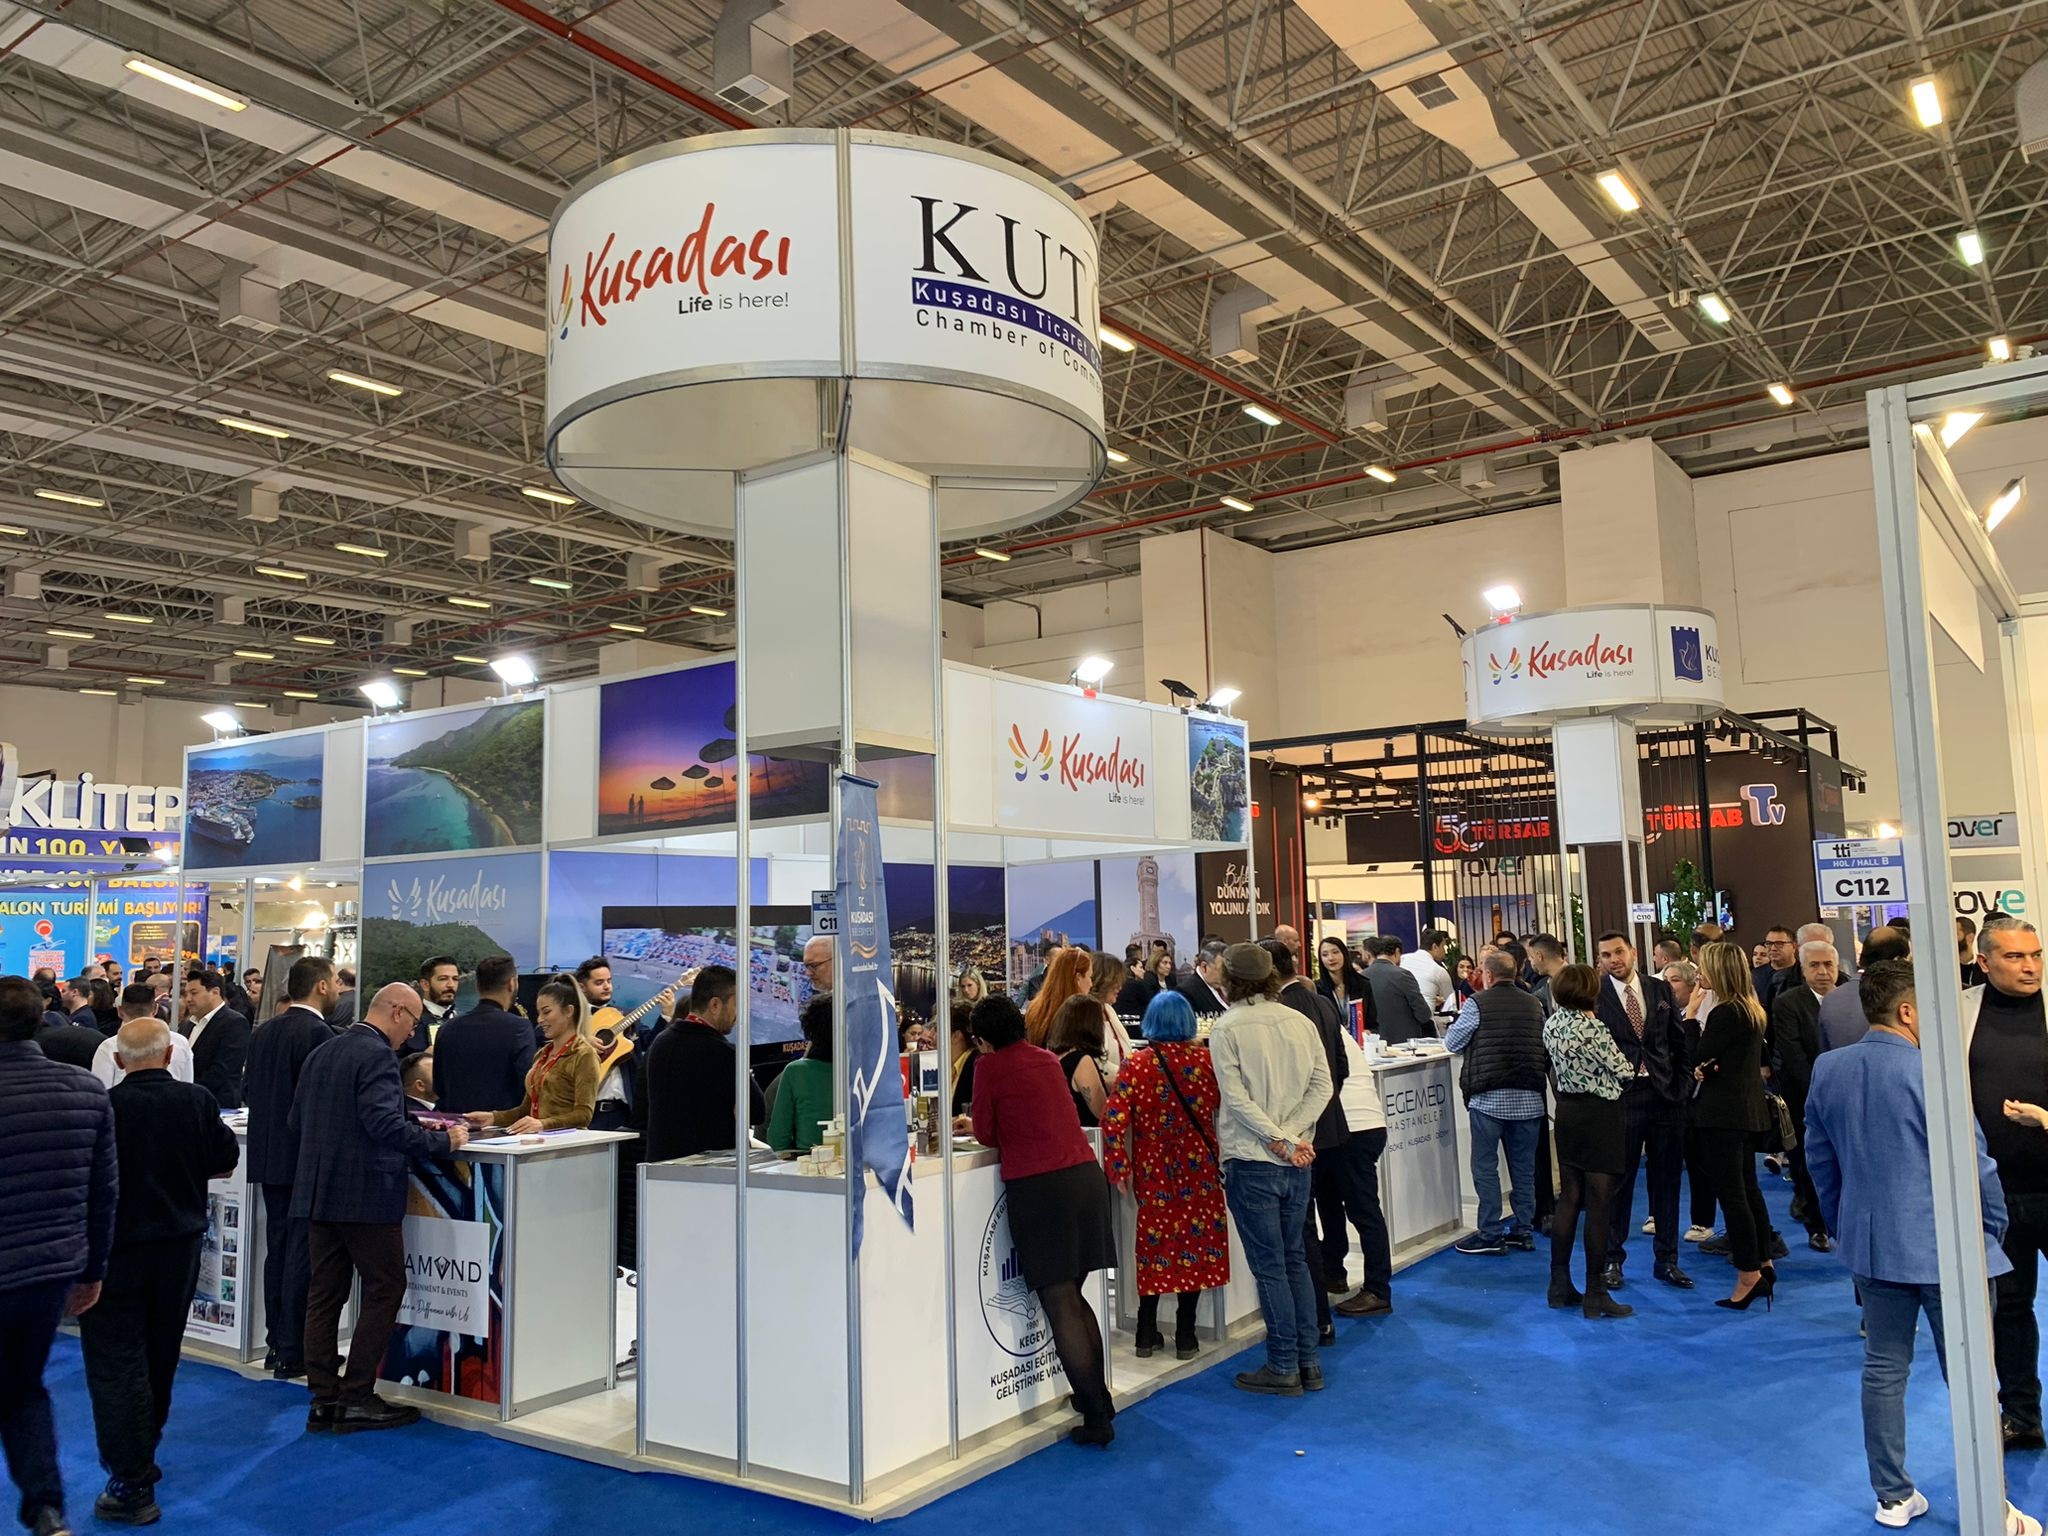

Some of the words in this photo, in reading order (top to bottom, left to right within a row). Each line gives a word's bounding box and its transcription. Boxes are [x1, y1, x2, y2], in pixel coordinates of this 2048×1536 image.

[911, 195, 1099, 345] KUT
[678, 296, 713, 315] Life
[718, 294, 733, 310] is
[738, 291, 790, 309] here!
[915, 281, 1026, 323] Kuşadası
[1036, 310, 1088, 356] Ticaret
[916, 308, 1028, 347] Chamber
[1039, 342, 1055, 358] of
[1586, 670, 1603, 679] Life
[1108, 792, 1121, 803] Life
[1471, 818, 1551, 841] TÜRSAB
[1832, 843, 1851, 858] tti
[1833, 860, 1850, 868] HOL
[1857, 858, 1880, 867] HALL
[1881, 856, 1889, 866] B
[1835, 877, 1890, 897] C112
[1209, 902, 1245, 915] YOLUNU
[1246, 902, 1271, 915] ADIK
[1953, 889, 2025, 915] ove
[1386, 1083, 1446, 1116] EGEMED
[1019, 1329, 1046, 1349] KEGEV
[990, 1359, 1034, 1388] KUŞADASI
[1034, 1347, 1059, 1369] EĞİTİ
[996, 1370, 1045, 1401] GELİŞTİRME
